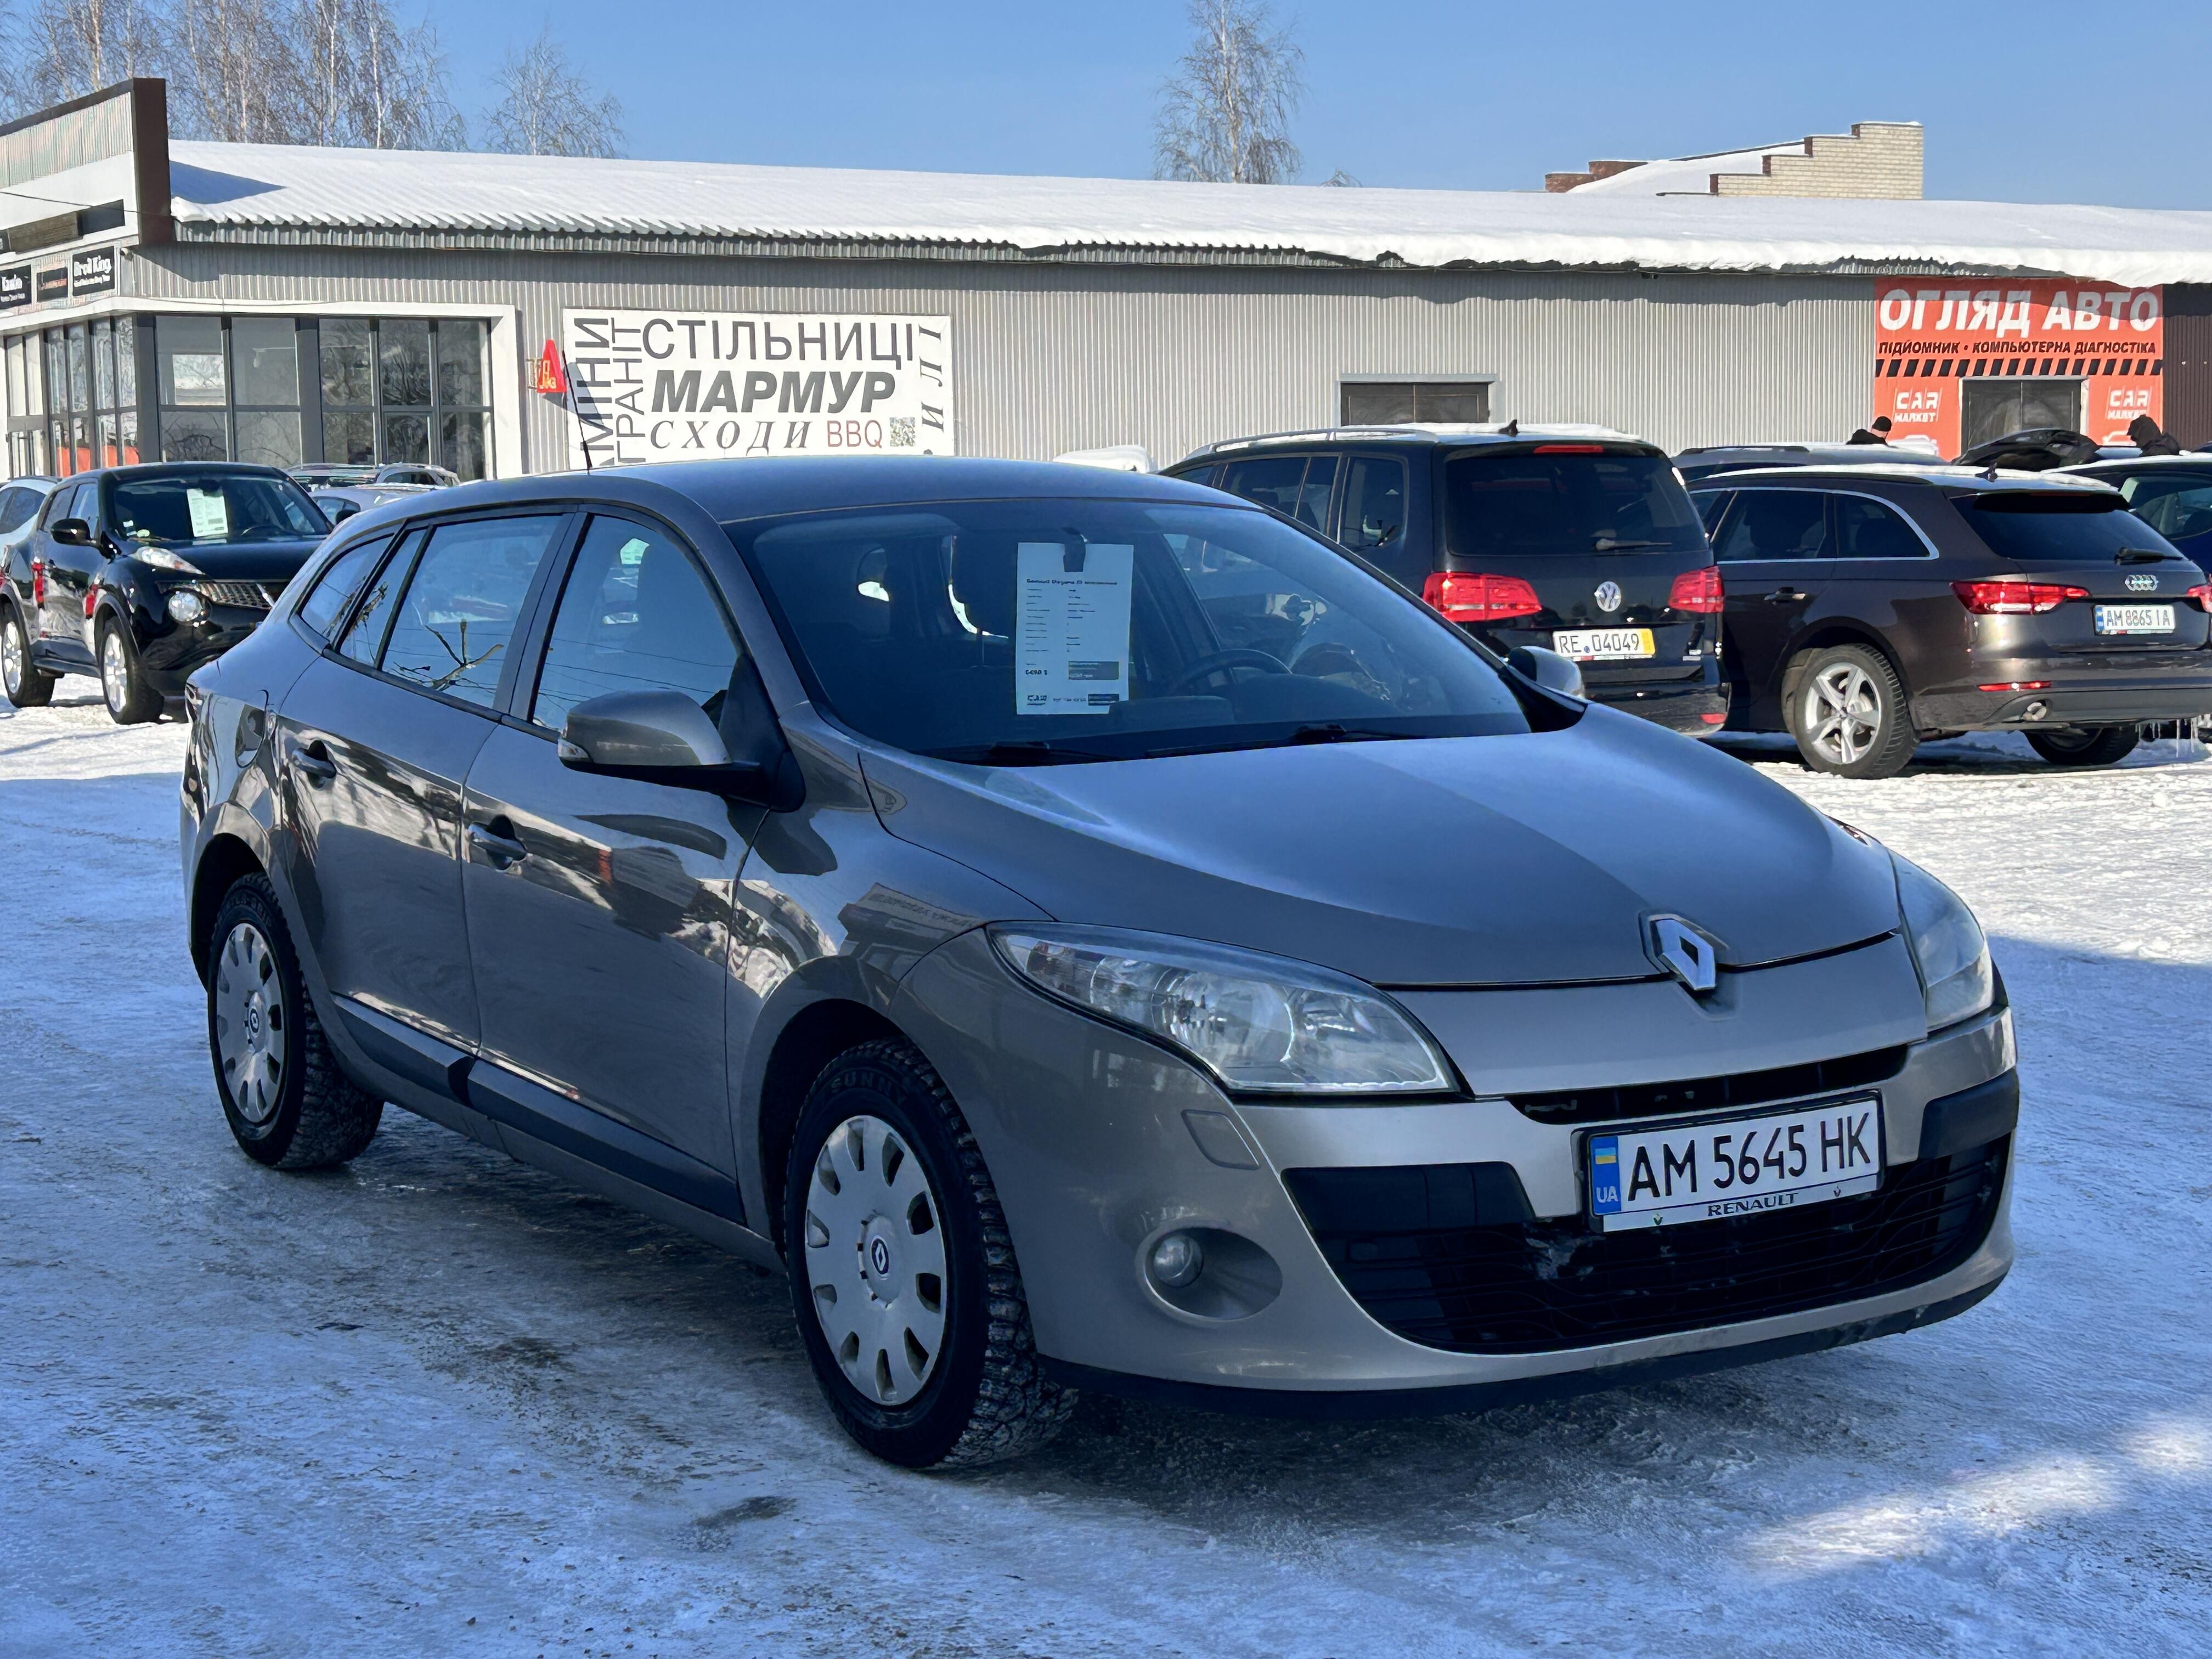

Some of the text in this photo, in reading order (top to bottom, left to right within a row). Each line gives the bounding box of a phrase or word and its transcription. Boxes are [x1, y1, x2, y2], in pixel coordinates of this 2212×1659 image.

[1880, 289, 2158, 338] ОГЛЯД АВТО
[642, 318, 913, 370] СТІЛЬНИЦІ
[1879, 340, 1960, 357] ПІДЙОМНИК
[611, 317, 646, 464] ГРАНІТ
[651, 369, 896, 414] МАРМУР
[1896, 391, 1939, 410] CAR
[2109, 390, 2149, 407] CAR
[650, 420, 813, 456] СХОДИ
[827, 420, 883, 449] BBQ
[2107, 610, 2124, 627] AM
[2157, 610, 2170, 626] IA
[1559, 634, 1640, 653] RE 04049
[1627, 1112, 1871, 1201] AM 5645 HK
[1596, 1186, 1618, 1203] UA
[1707, 1193, 1799, 1216] RENAULT
